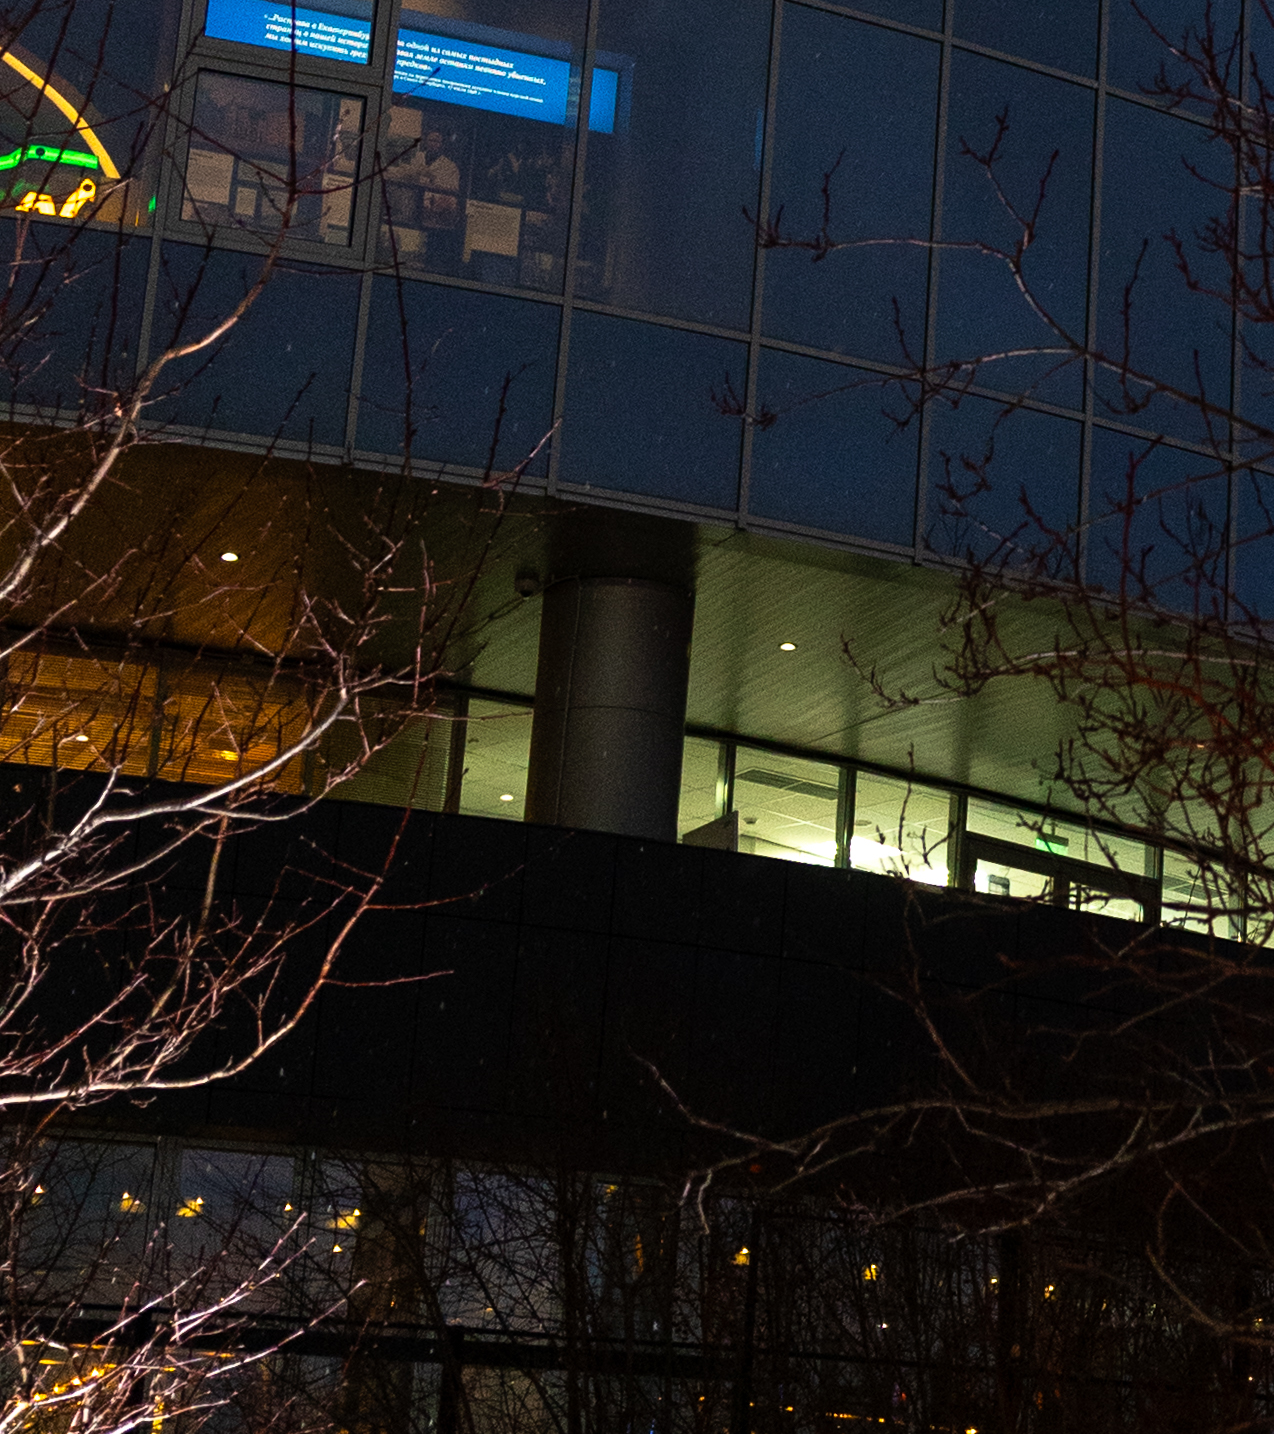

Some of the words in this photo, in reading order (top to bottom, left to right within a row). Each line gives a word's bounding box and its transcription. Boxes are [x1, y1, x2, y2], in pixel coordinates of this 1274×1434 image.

[318, 22, 370, 41] Екатеринбур
[337, 37, 369, 49] истори
[349, 49, 367, 59] грех
